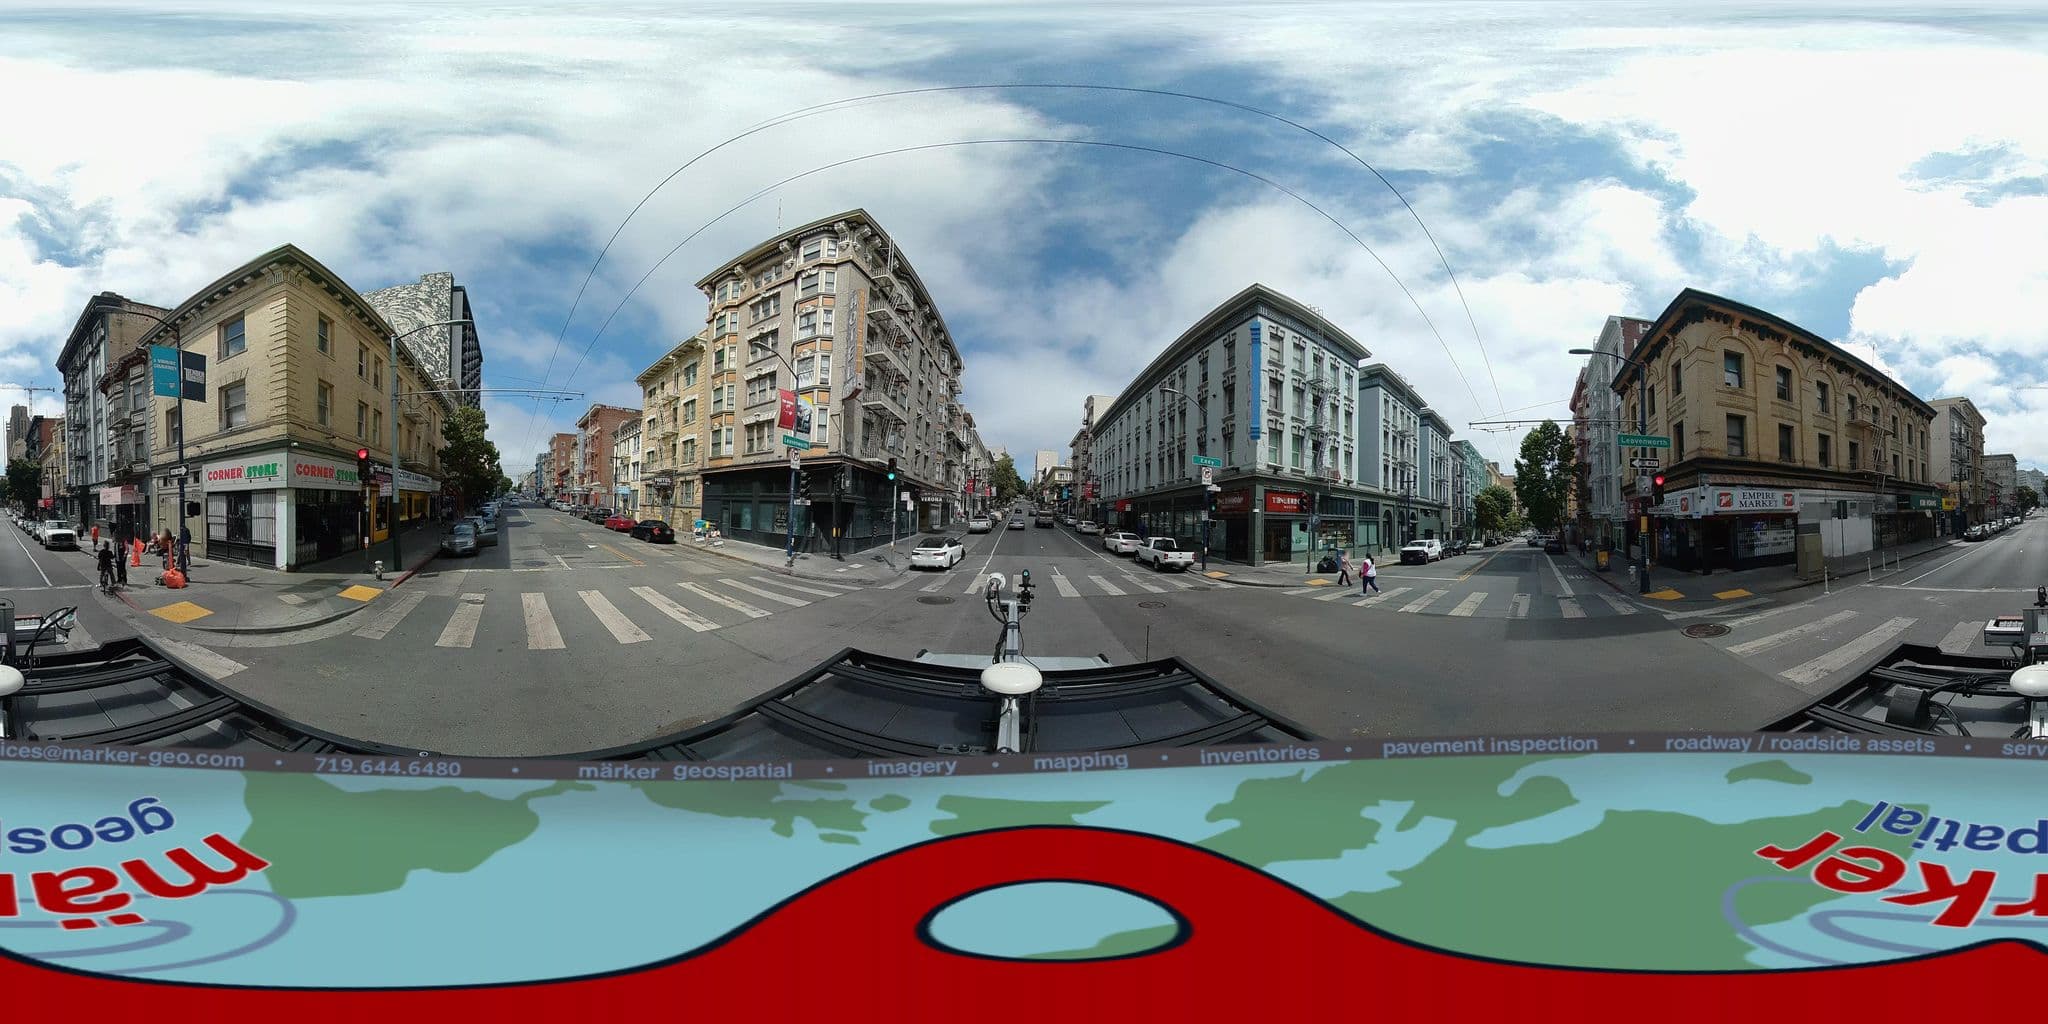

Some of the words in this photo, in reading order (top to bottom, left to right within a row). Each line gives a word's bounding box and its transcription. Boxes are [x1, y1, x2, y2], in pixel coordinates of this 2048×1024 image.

[1621, 436, 1668, 446] Leavenworth
[207, 466, 243, 481] CORNER
[246, 463, 278, 478] STORE
[295, 463, 335, 479] CORNER
[1742, 491, 1776, 500] EMPIRE
[1739, 500, 1777, 508] MARKET
